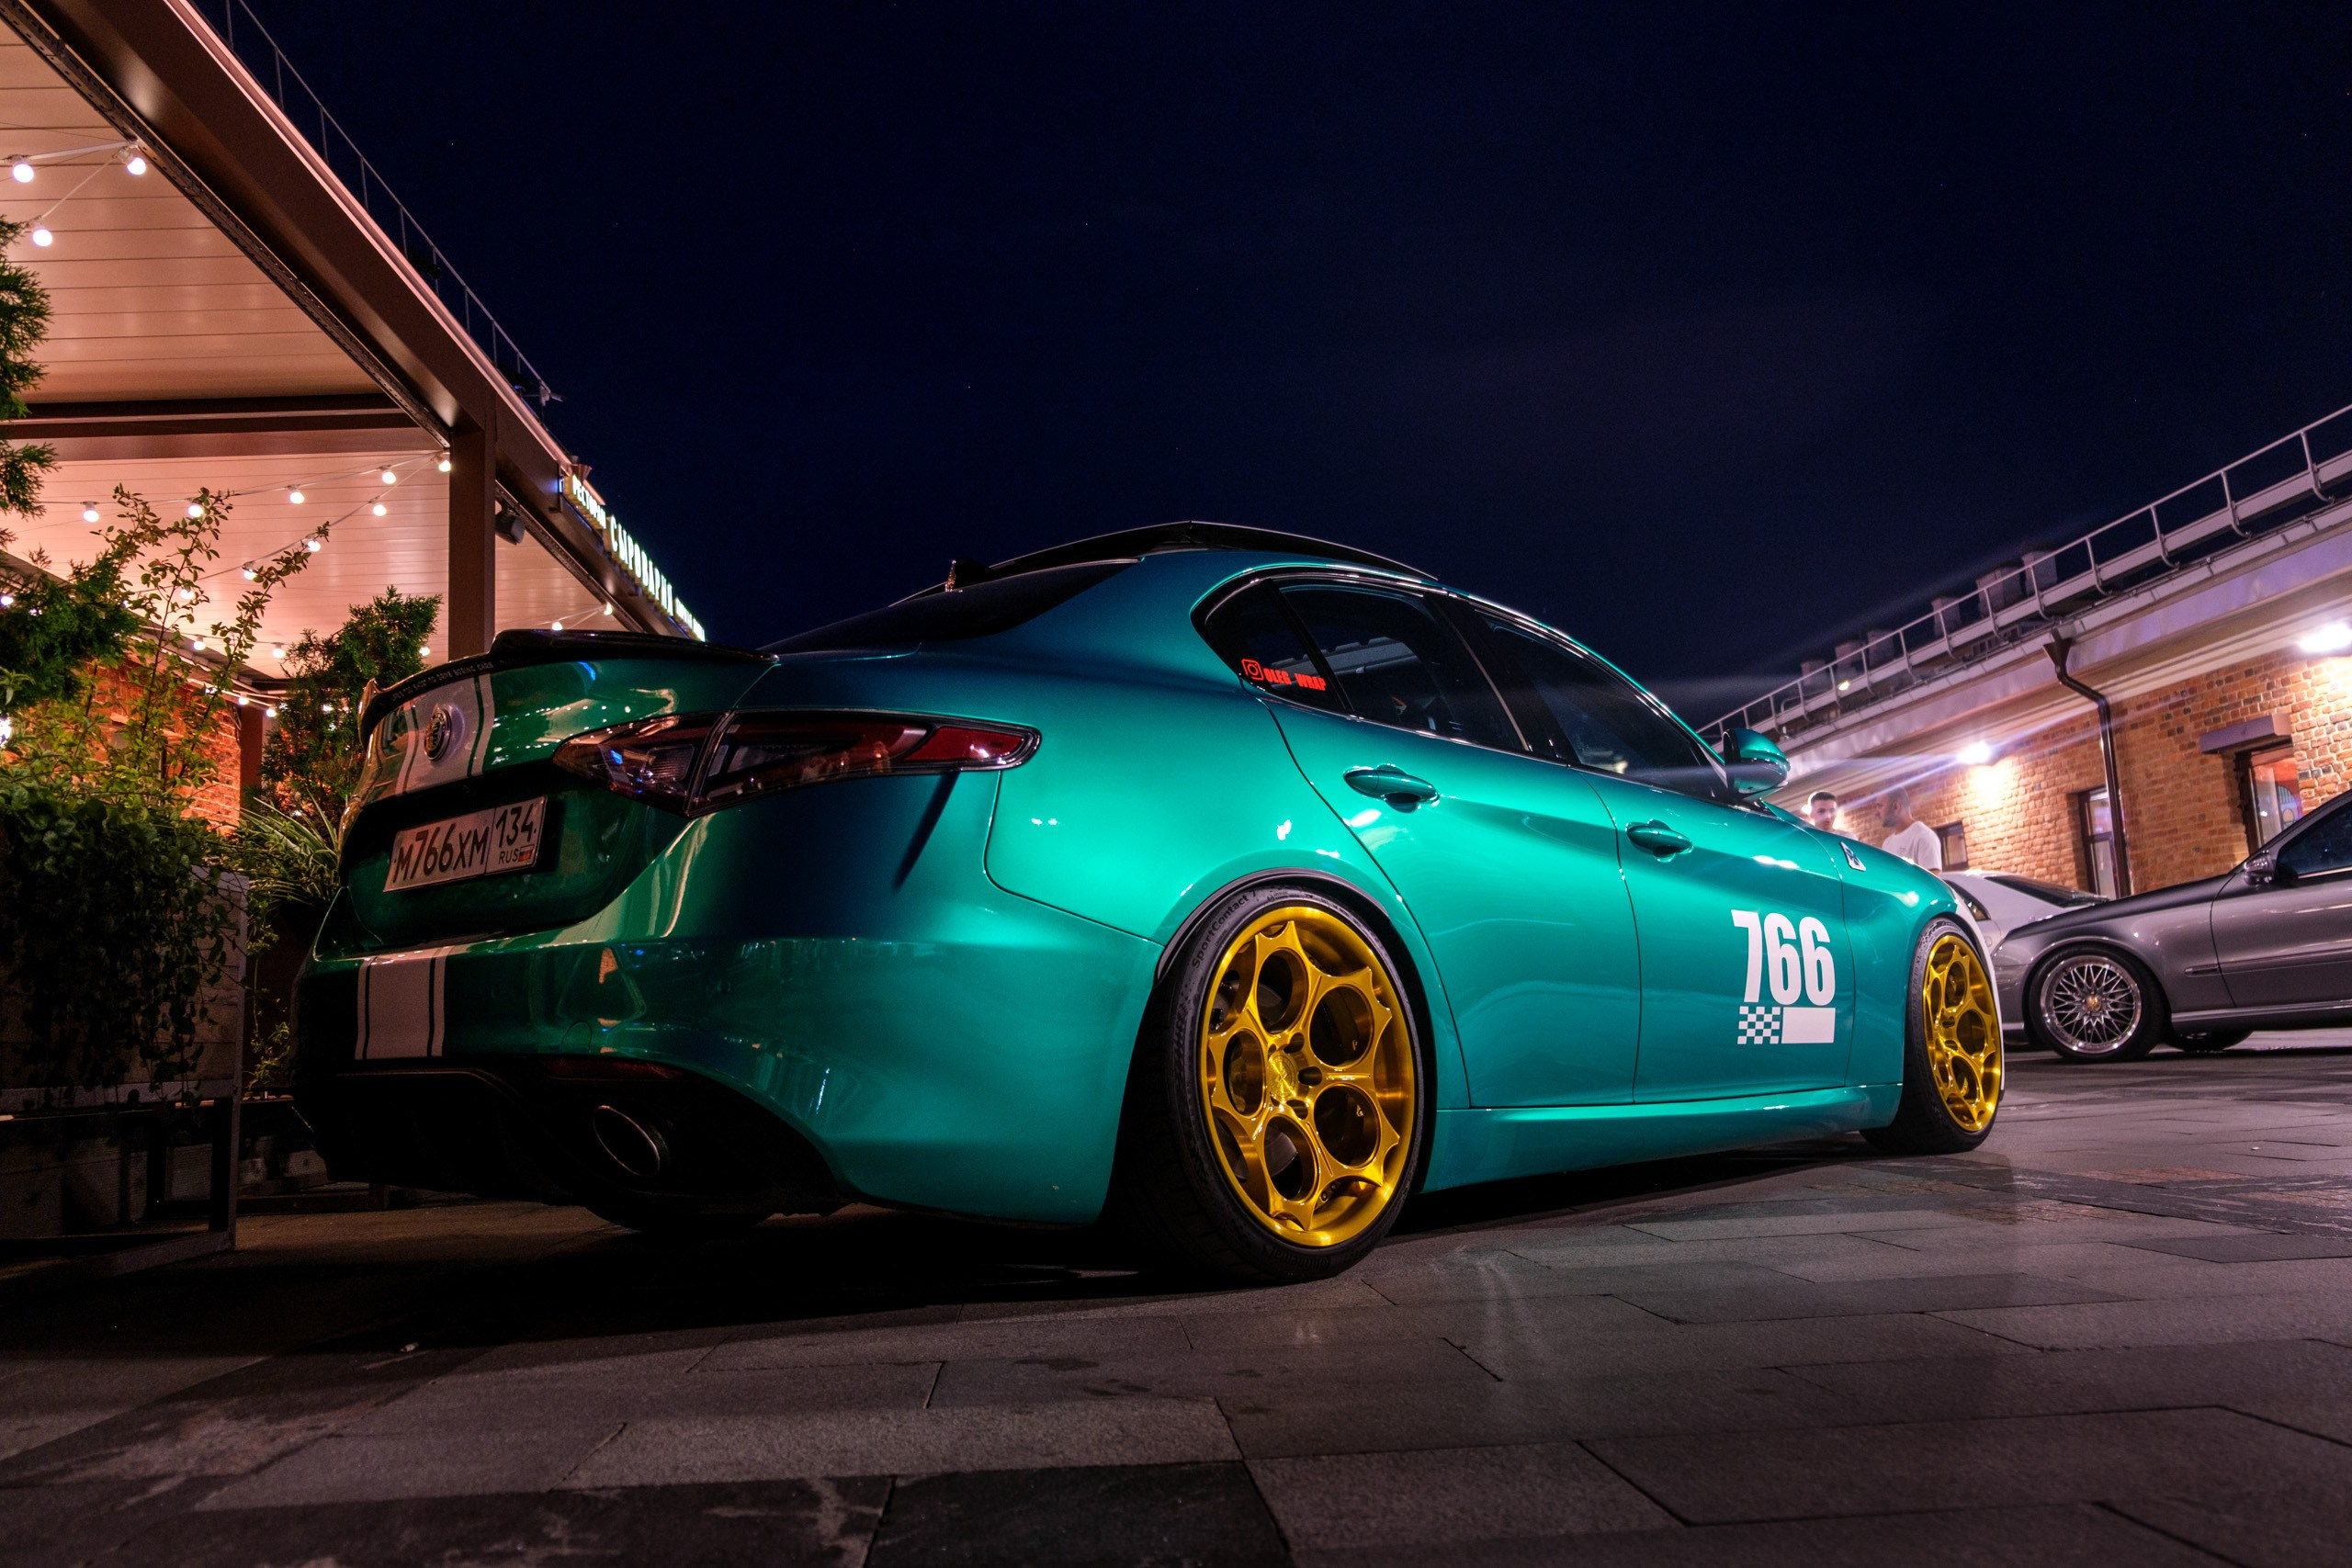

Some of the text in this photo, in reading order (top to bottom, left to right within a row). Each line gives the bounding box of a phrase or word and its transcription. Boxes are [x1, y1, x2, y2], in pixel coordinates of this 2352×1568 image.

[610, 514, 673, 616] СЫРОВАРНЯ
[1262, 667, 1328, 692] OLEG WRAP
[496, 803, 534, 848] 134
[498, 848, 519, 864] RUS
[1192, 895, 1250, 969] SportContact
[1731, 909, 1836, 1007] 766
